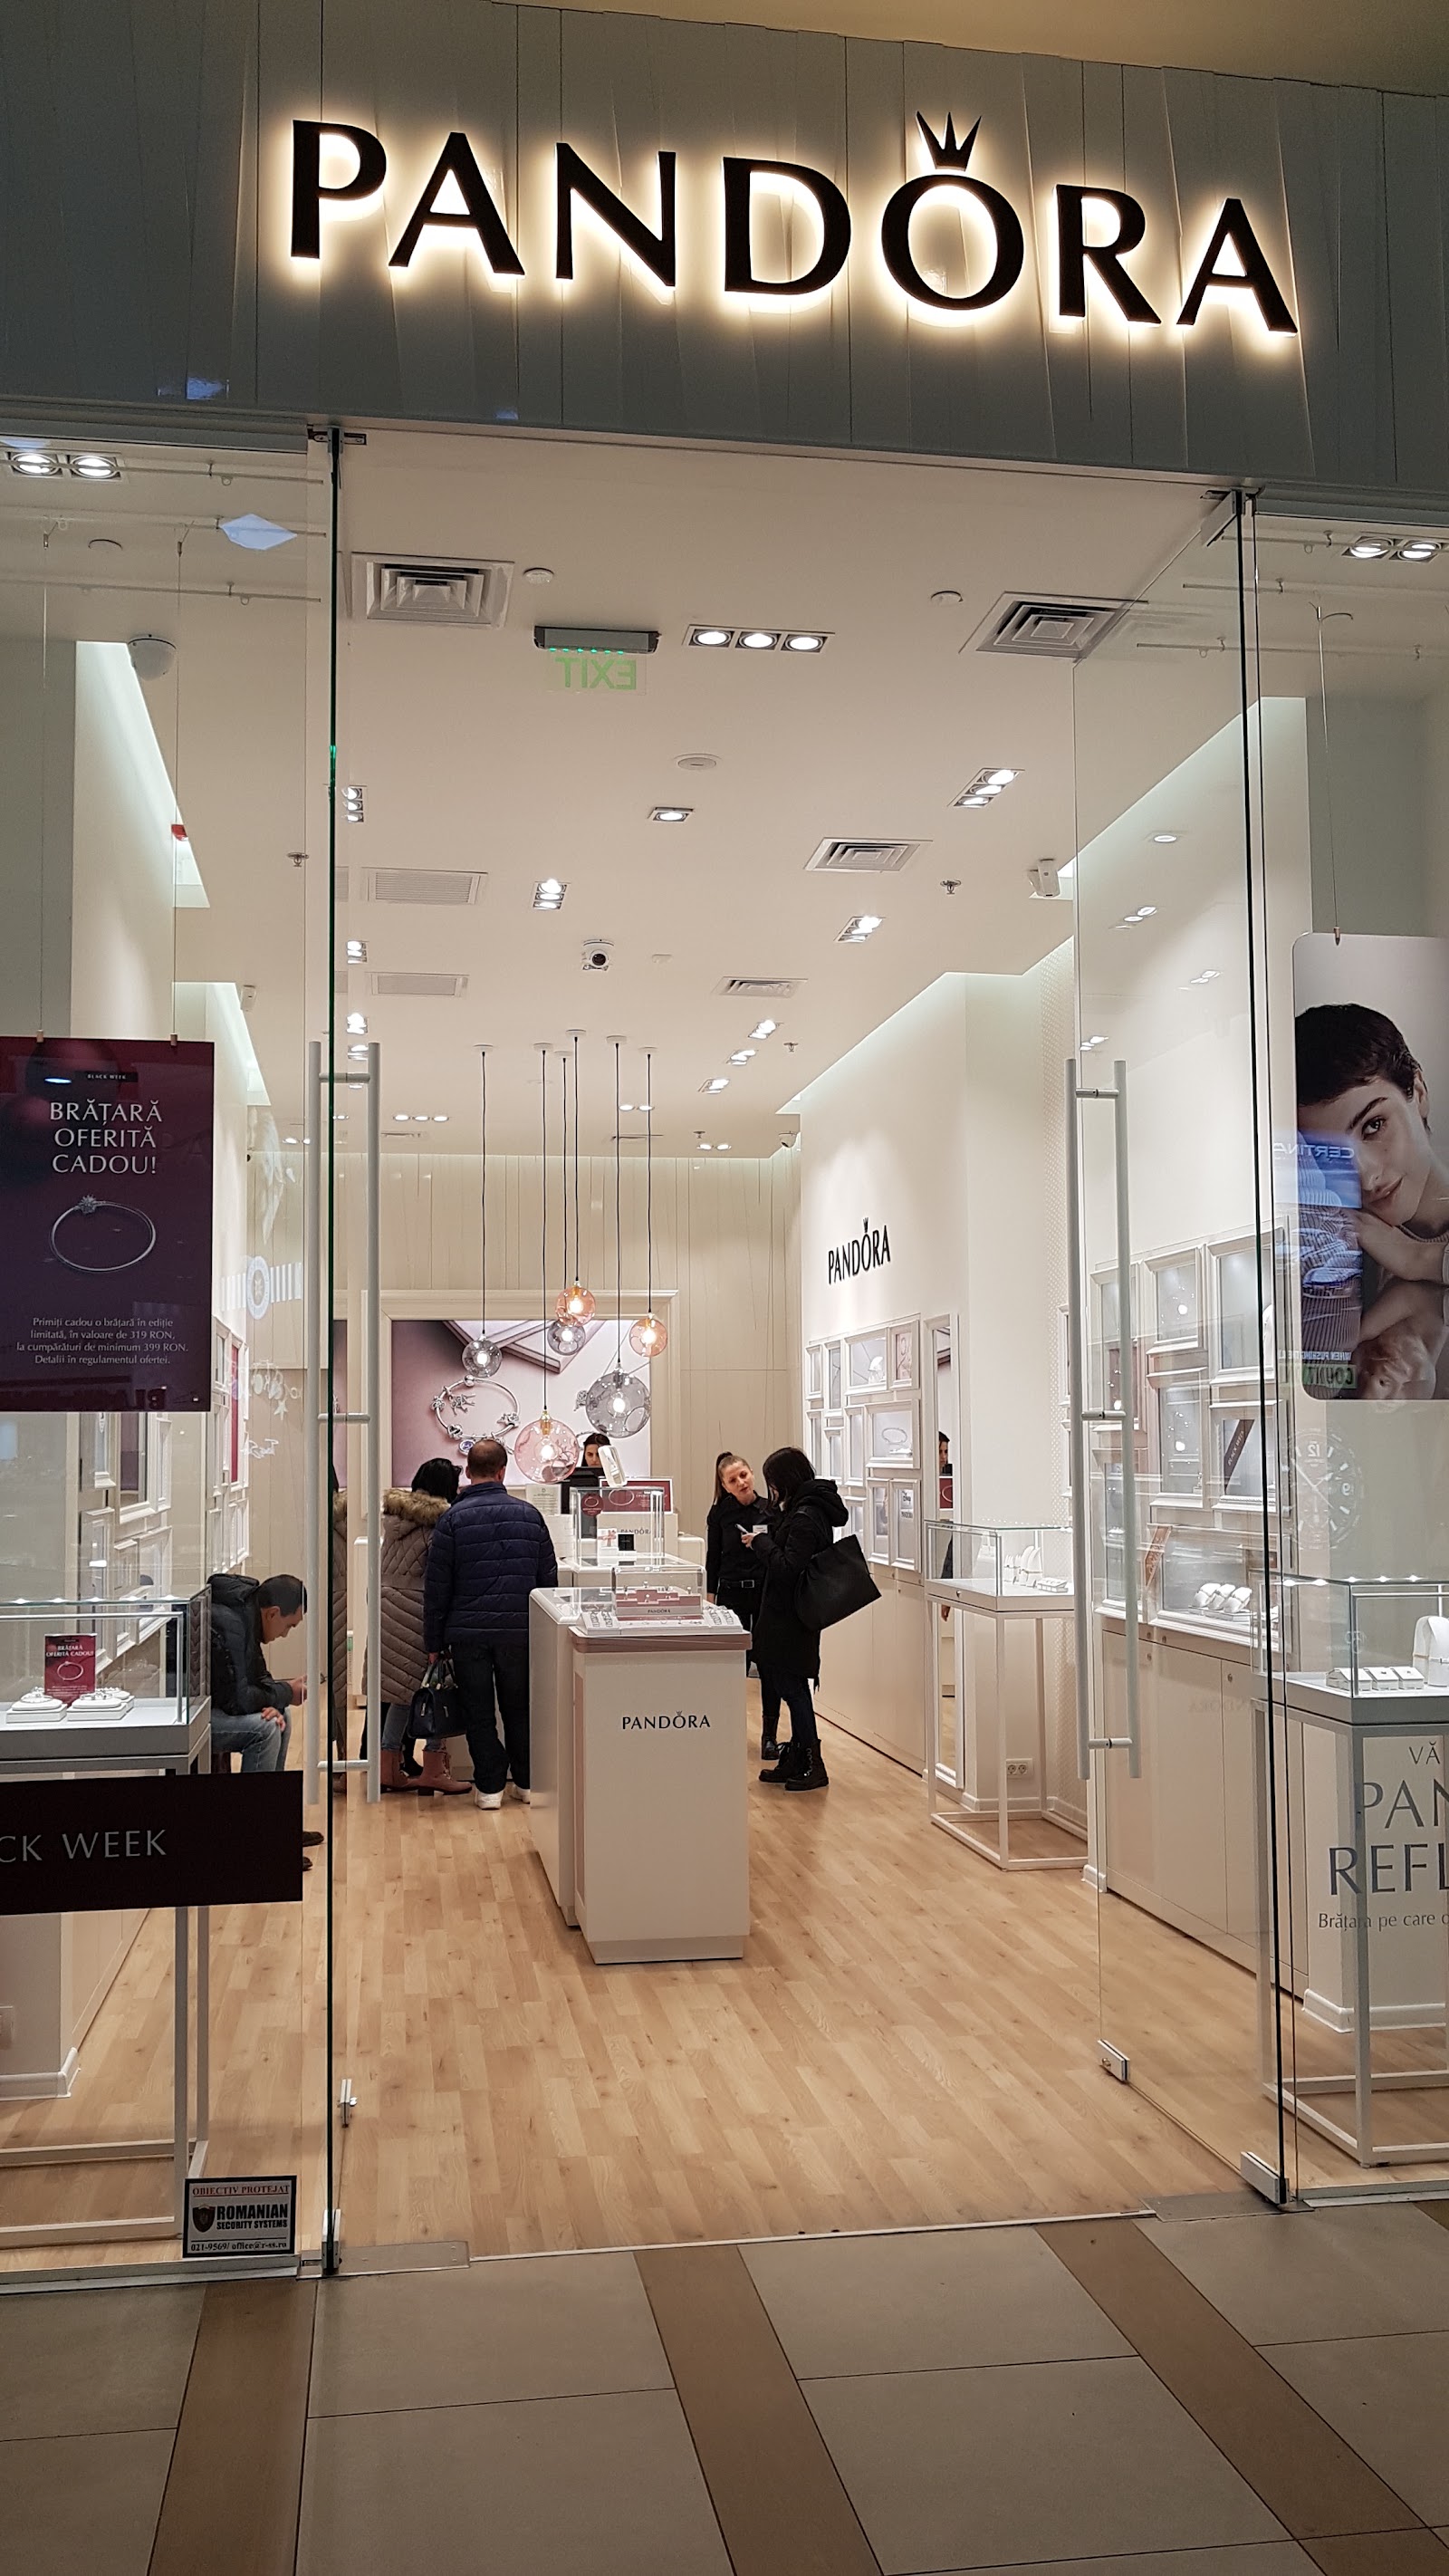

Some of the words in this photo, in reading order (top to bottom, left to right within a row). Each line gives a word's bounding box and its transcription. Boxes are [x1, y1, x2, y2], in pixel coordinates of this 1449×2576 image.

[291, 110, 1298, 336] PANDORA
[49, 1098, 163, 1126] BRĂȚARĂ
[54, 1126, 157, 1149] OFERITĂ
[52, 1153, 156, 1175] CADOU!
[828, 1216, 891, 1286] PANDORA
[33, 1317, 62, 1328] Primiți
[64, 1317, 93, 1327] cadou
[104, 1317, 135, 1328] brățară
[137, 1318, 146, 1327] în
[149, 1318, 174, 1329] ediție
[69, 1330, 79, 1339] în
[81, 1330, 114, 1340] valoare
[116, 1330, 128, 1340] de
[130, 1331, 147, 1340] 319
[149, 1331, 176, 1340] RON,
[16, 1341, 25, 1351] la
[27, 1342, 82, 1353] cumpărături
[83, 1341, 95, 1351] de
[98, 1342, 141, 1351] minimum
[144, 1343, 161, 1351] 399
[163, 1343, 188, 1351] RON.
[35, 1355, 65, 1364] Detalii
[67, 1355, 76, 1364] în
[79, 1355, 138, 1367] regulamentul
[139, 1354, 171, 1364] ofertei.
[622, 1710, 711, 1730] PANDORA
[1408, 1741, 1441, 1764] VĂ
[62, 1829, 167, 1860] WEEK
[1378, 1915, 1397, 1932] pe
[1403, 1913, 1435, 1927] care
[192, 2186, 239, 2196] OBIECTIV
[241, 2185, 290, 2194] PROTEJAT
[216, 2204, 288, 2220] ROMANIAN
[216, 2220, 253, 2230] SECURITY
[254, 2219, 288, 2229] SYSTEMS
